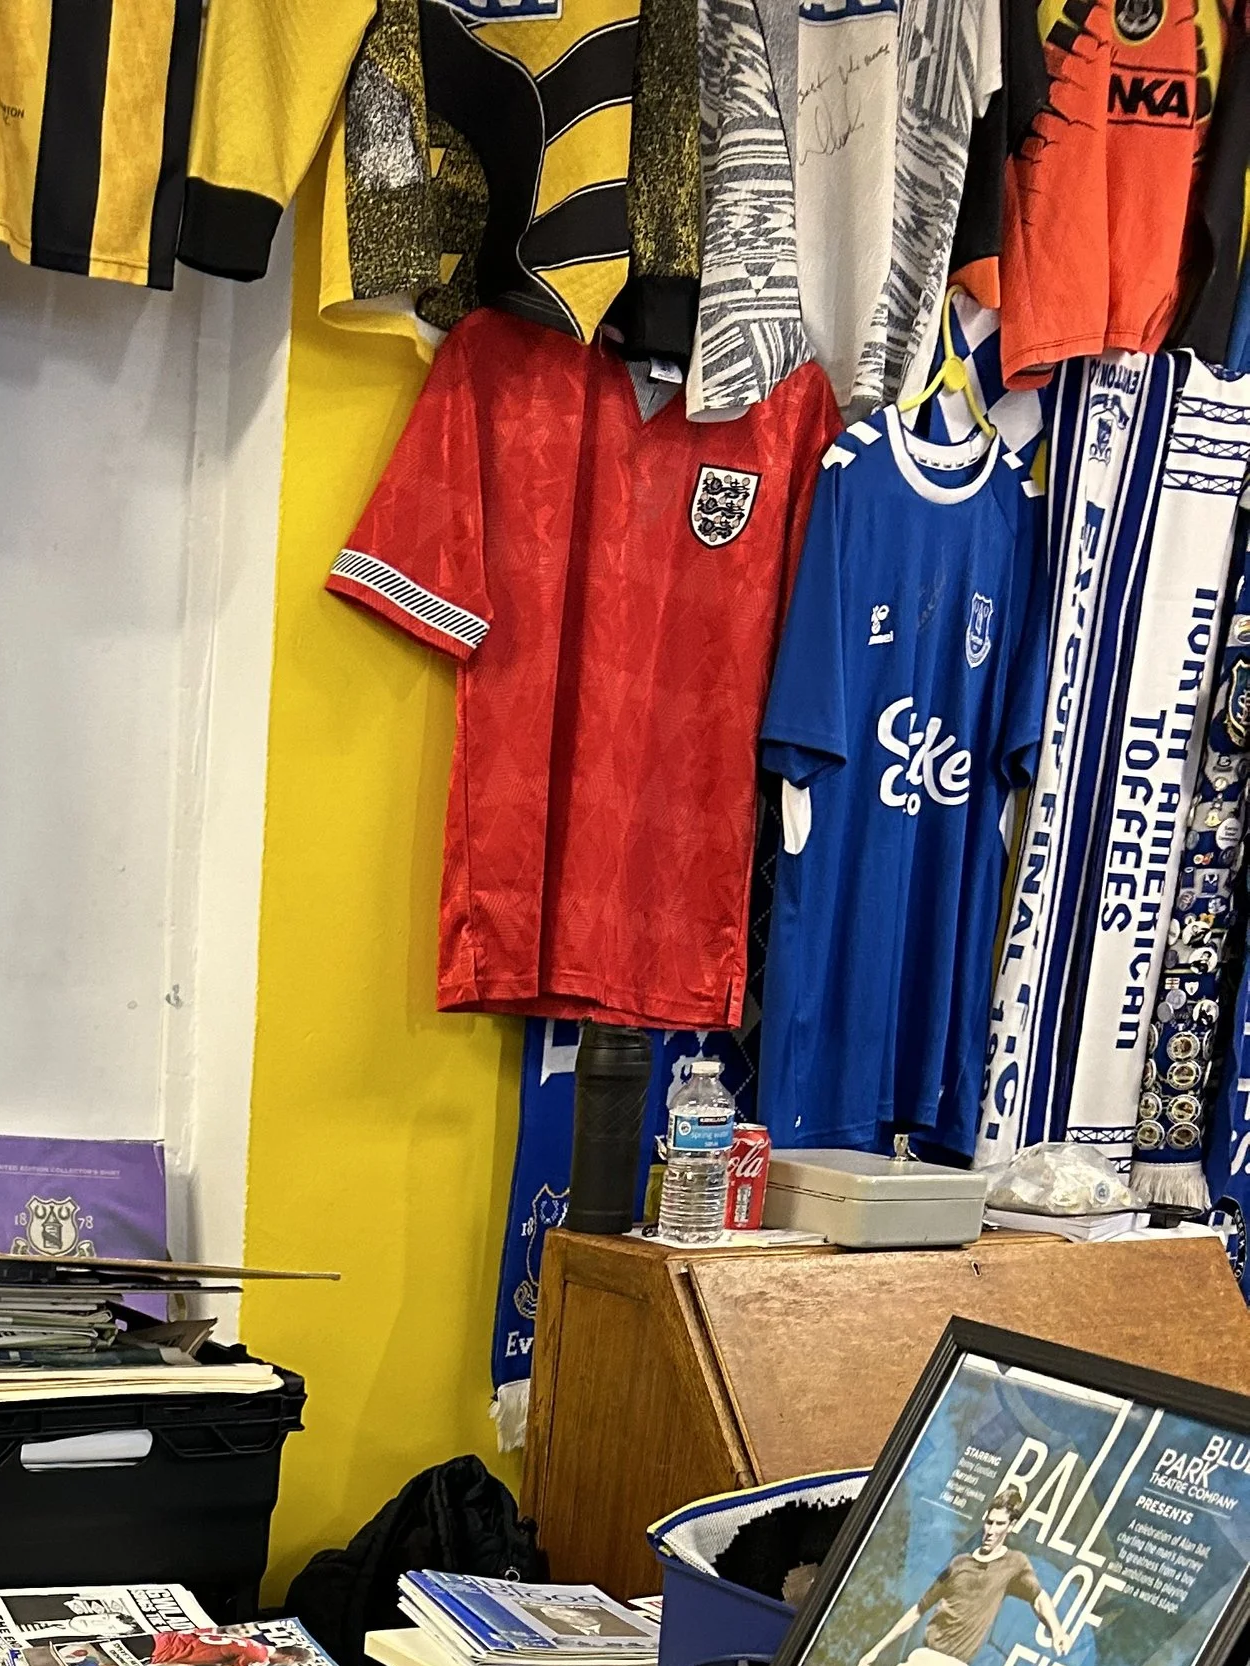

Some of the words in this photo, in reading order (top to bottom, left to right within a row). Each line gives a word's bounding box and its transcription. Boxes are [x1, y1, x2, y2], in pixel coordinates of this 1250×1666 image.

[1101, 709, 1167, 934] TOFFEES
[997, 792, 1057, 975] FINAL
[14, 1215, 27, 1226] 18
[78, 1216, 93, 1230] 78
[965, 1446, 1001, 1466] STARRING
[1155, 1448, 1220, 1488] PARK
[1150, 1472, 1188, 1495] THEATRE
[1187, 1484, 1238, 1510] COMPANY
[1135, 1496, 1194, 1525] PRESENTS
[1134, 1522, 1172, 1542] celebration
[1034, 1564, 1128, 1651] OF
